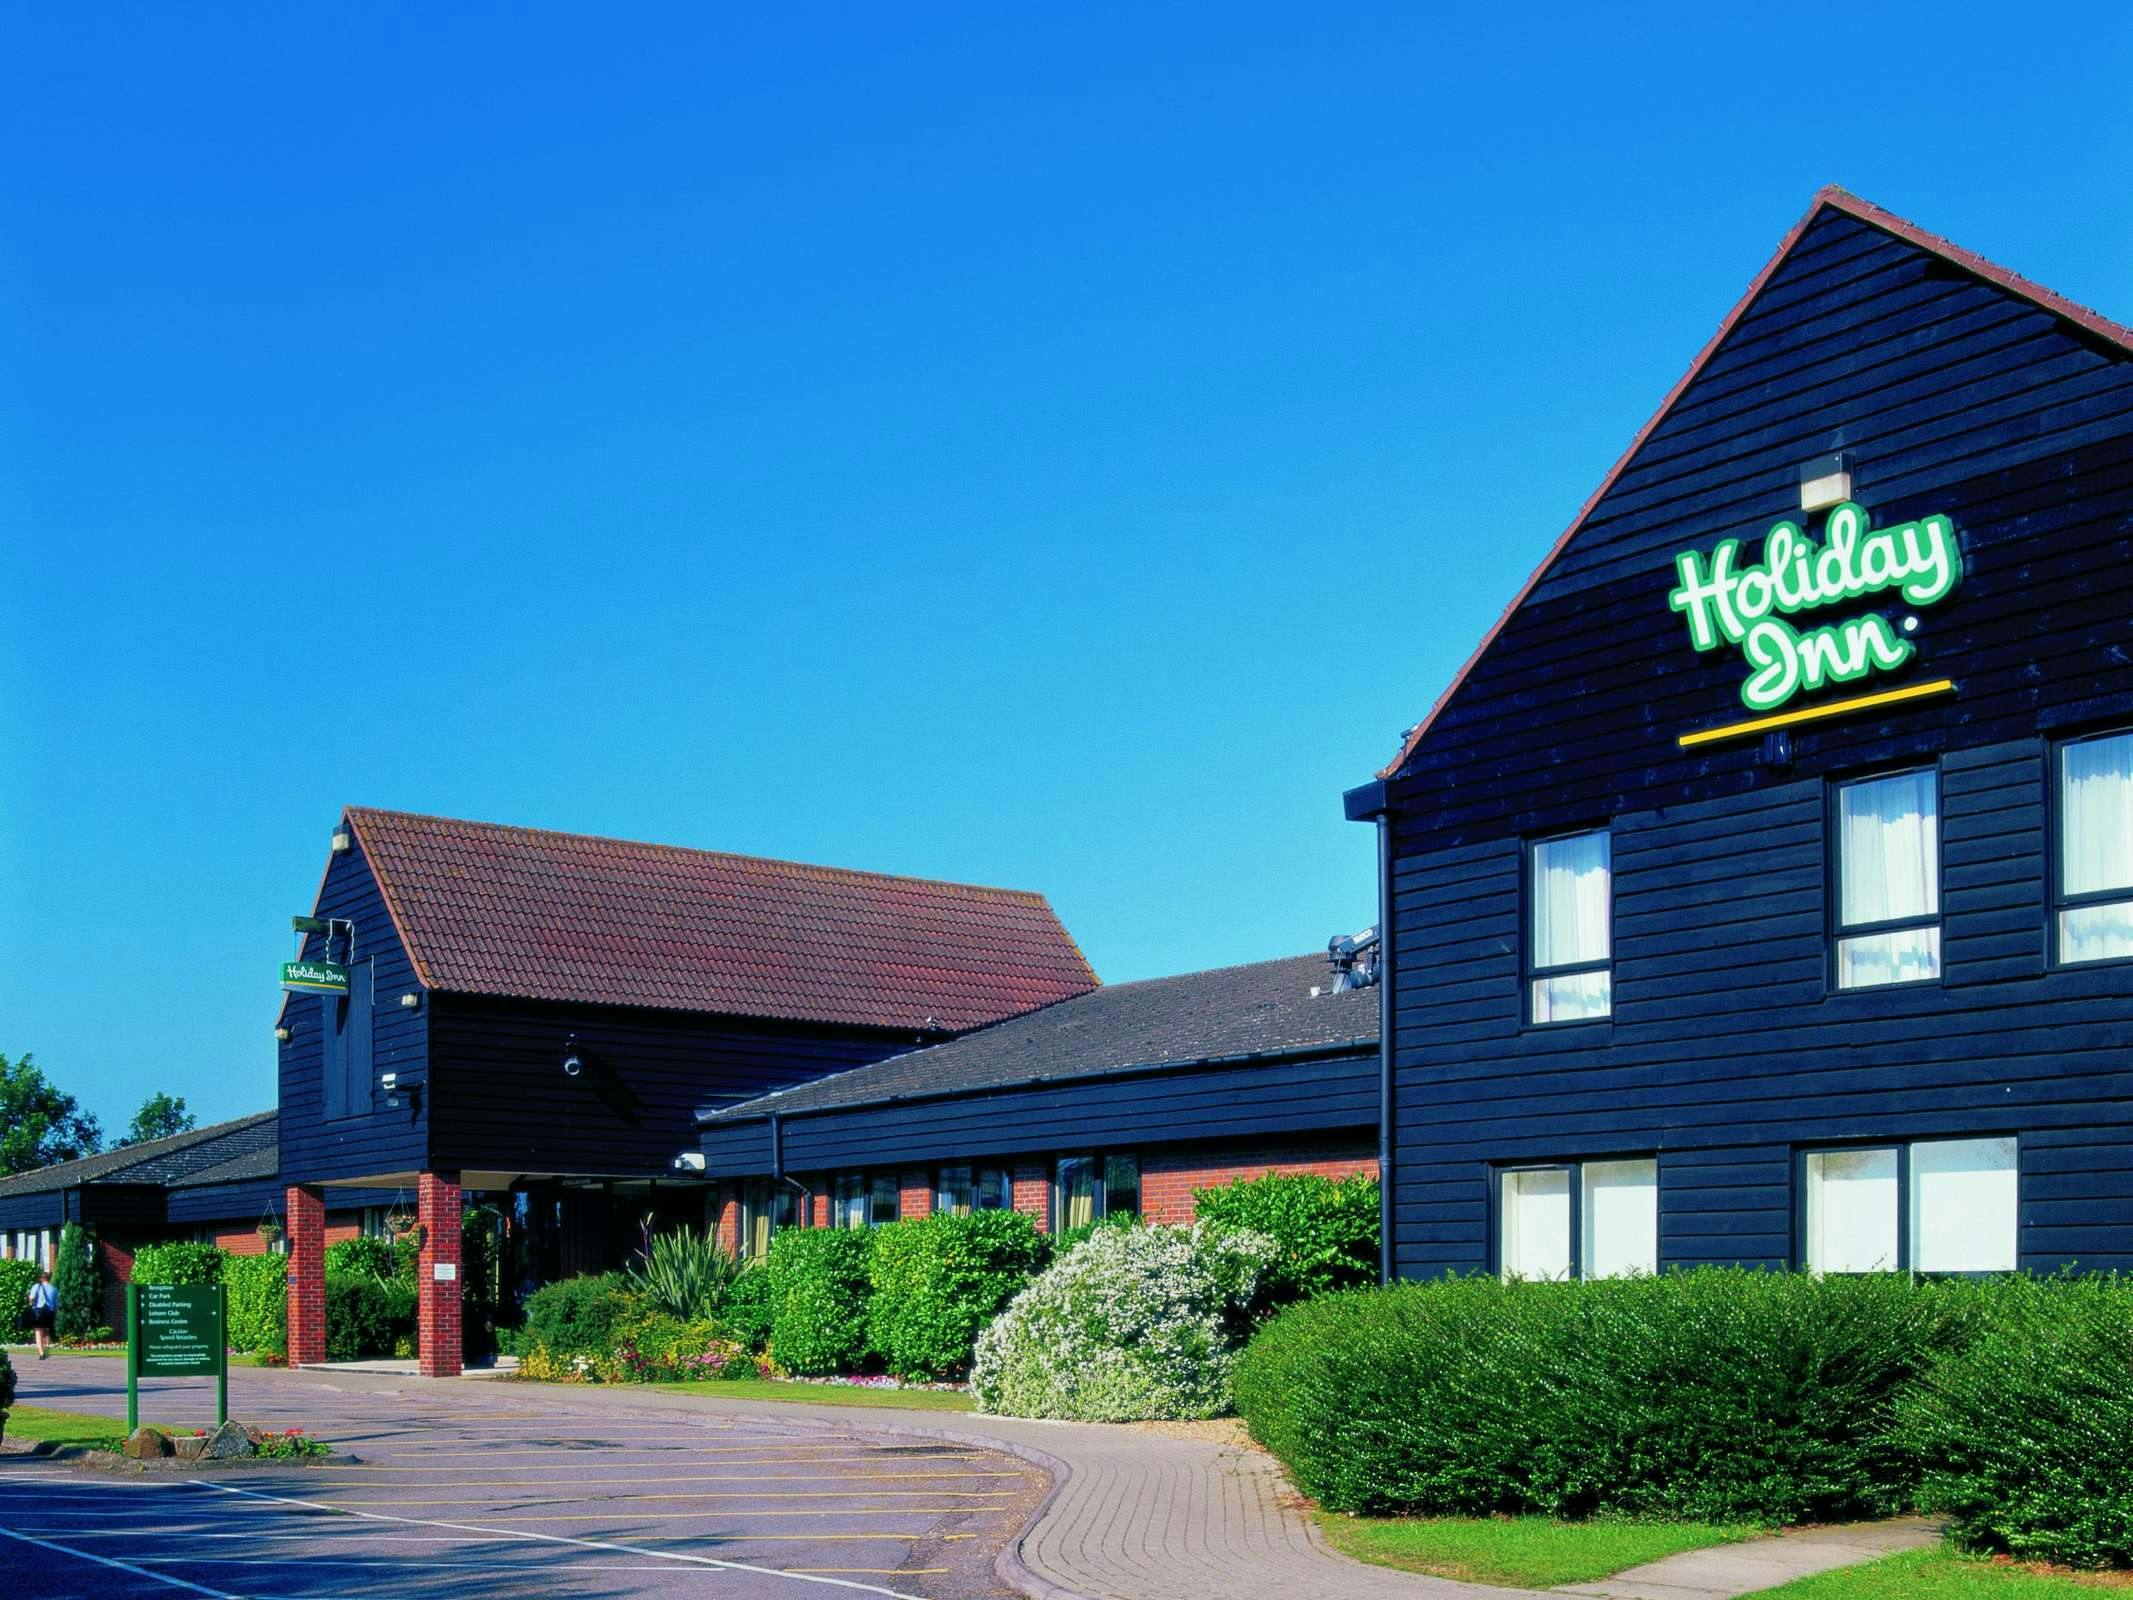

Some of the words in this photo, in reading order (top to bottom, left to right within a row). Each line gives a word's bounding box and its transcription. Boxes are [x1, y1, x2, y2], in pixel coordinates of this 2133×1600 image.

[1670, 504, 1958, 651] Holiday
[1741, 614, 1910, 710] Inn
[286, 965, 325, 982] Holiday
[326, 970, 346, 982] Inn
